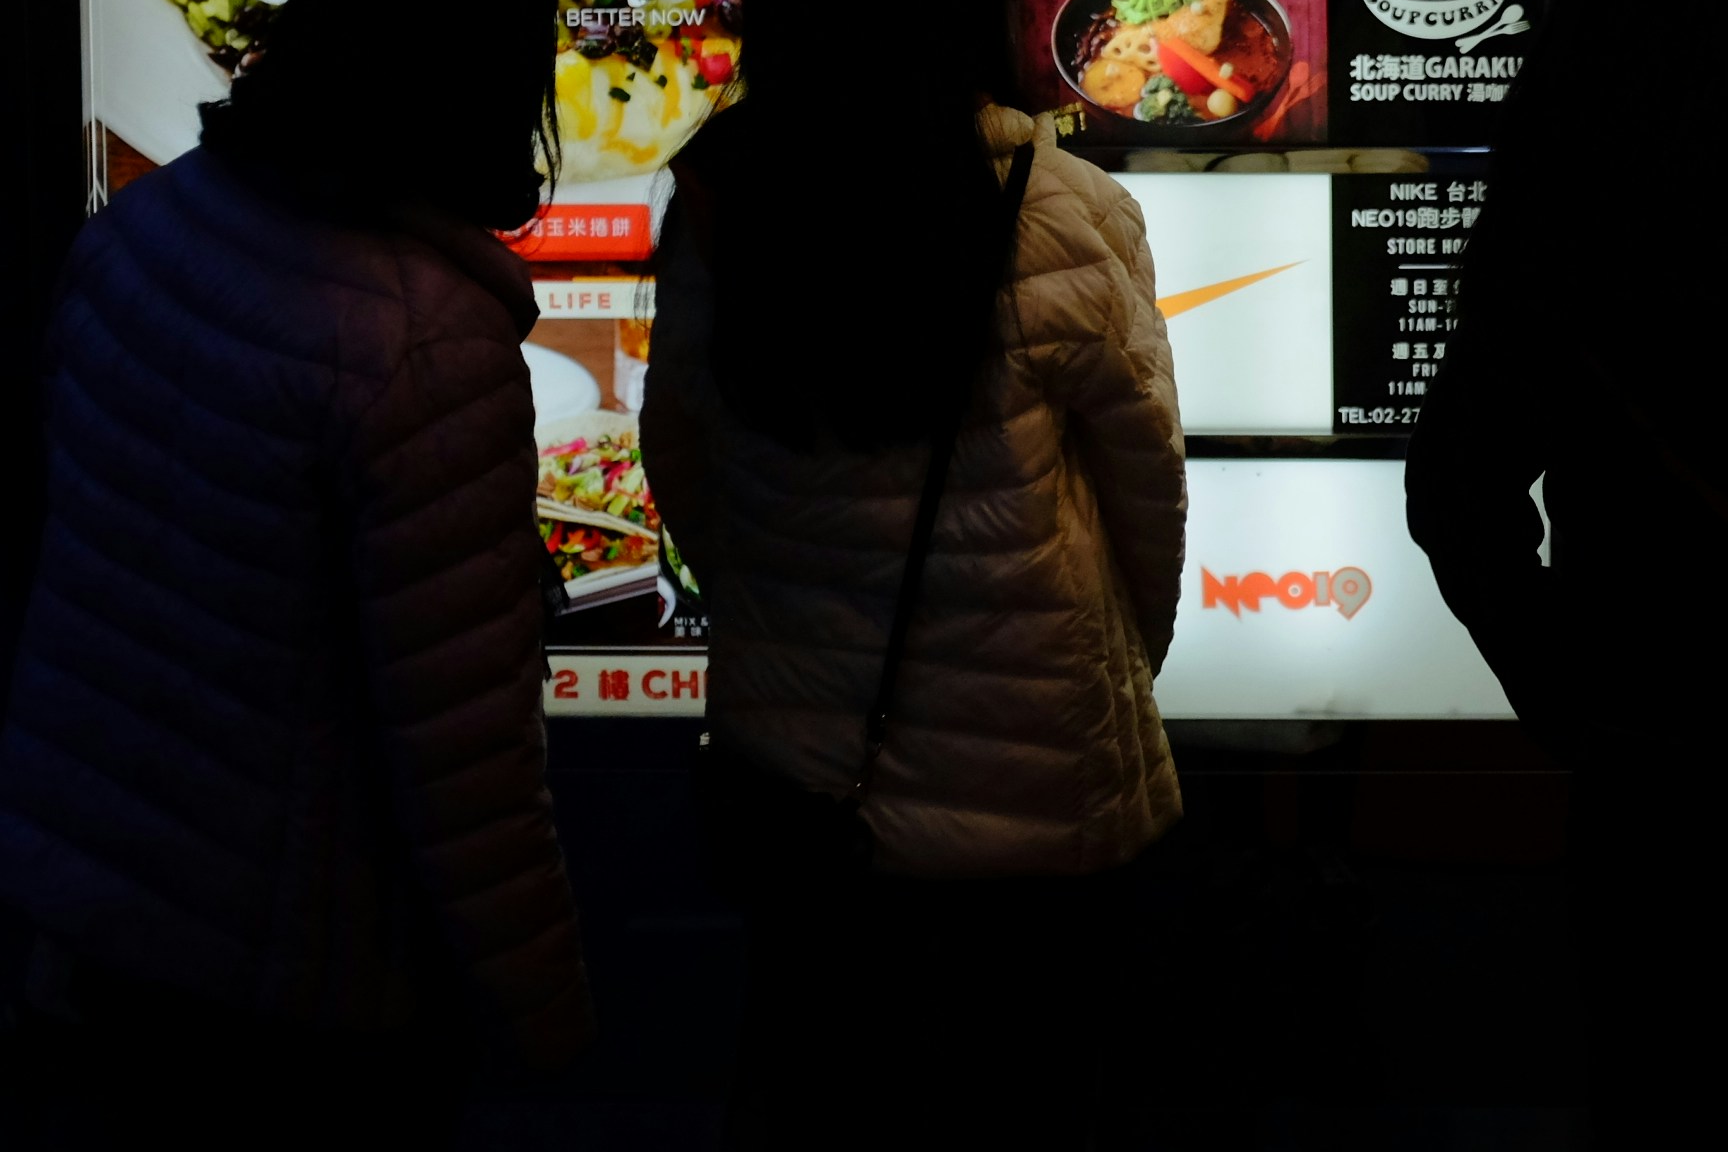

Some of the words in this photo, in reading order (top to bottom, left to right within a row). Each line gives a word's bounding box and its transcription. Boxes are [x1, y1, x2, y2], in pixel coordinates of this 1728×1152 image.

[566, 8, 646, 27] BETTER
[650, 8, 706, 26] NOW
[1350, 53, 1524, 81] 北海道GARAKU
[1350, 83, 1402, 102] SOUP
[1402, 83, 1464, 102] CURRY
[1390, 182, 1438, 201] NIKE
[1387, 238, 1437, 255] STORE
[549, 292, 612, 309] LIFE
[553, 670, 580, 699] 2
[598, 670, 630, 699] 樓
